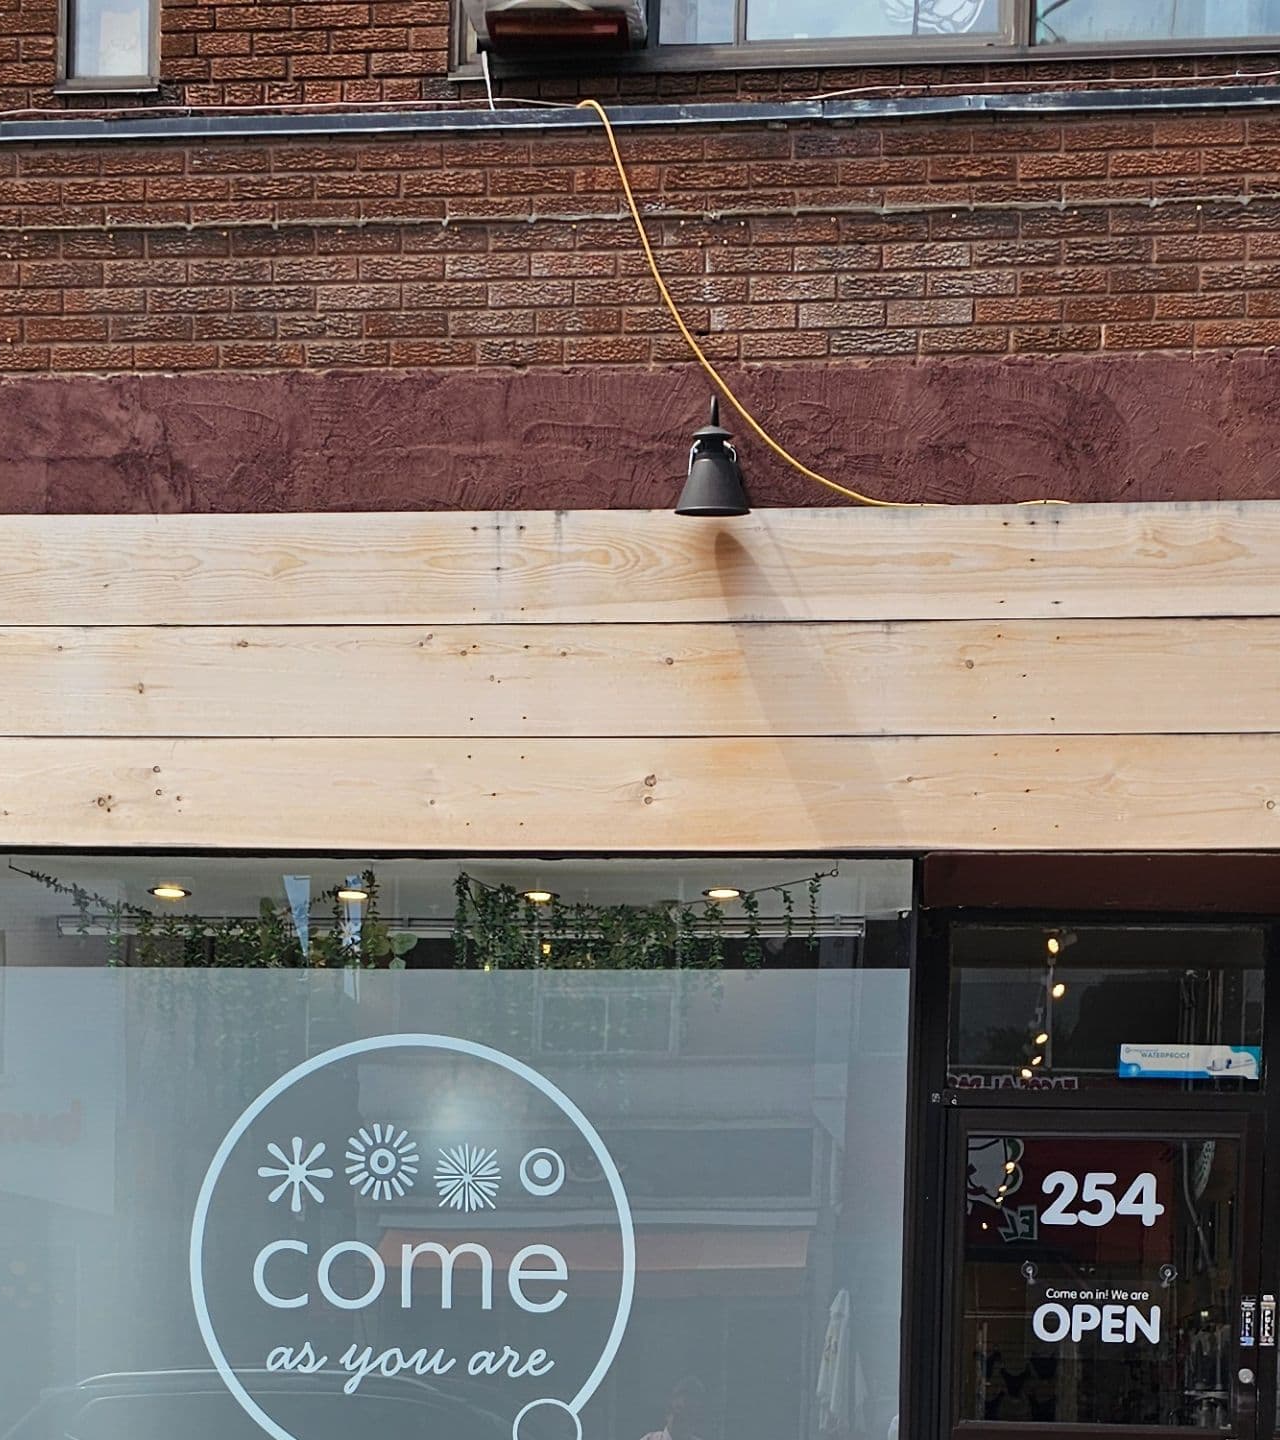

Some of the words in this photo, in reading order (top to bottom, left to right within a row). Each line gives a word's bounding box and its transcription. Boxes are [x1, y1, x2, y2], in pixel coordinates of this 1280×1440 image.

[1040, 1170, 1165, 1227] 254
[253, 1239, 569, 1314] come
[1045, 1288, 1077, 1300] Come
[1079, 1289, 1094, 1300] on
[1095, 1288, 1109, 1300] in!
[1110, 1289, 1128, 1300] We
[1130, 1291, 1149, 1301] are
[1032, 1303, 1161, 1344] OPEN
[266, 1342, 328, 1374] as
[339, 1343, 456, 1395] you
[467, 1345, 556, 1378] are
